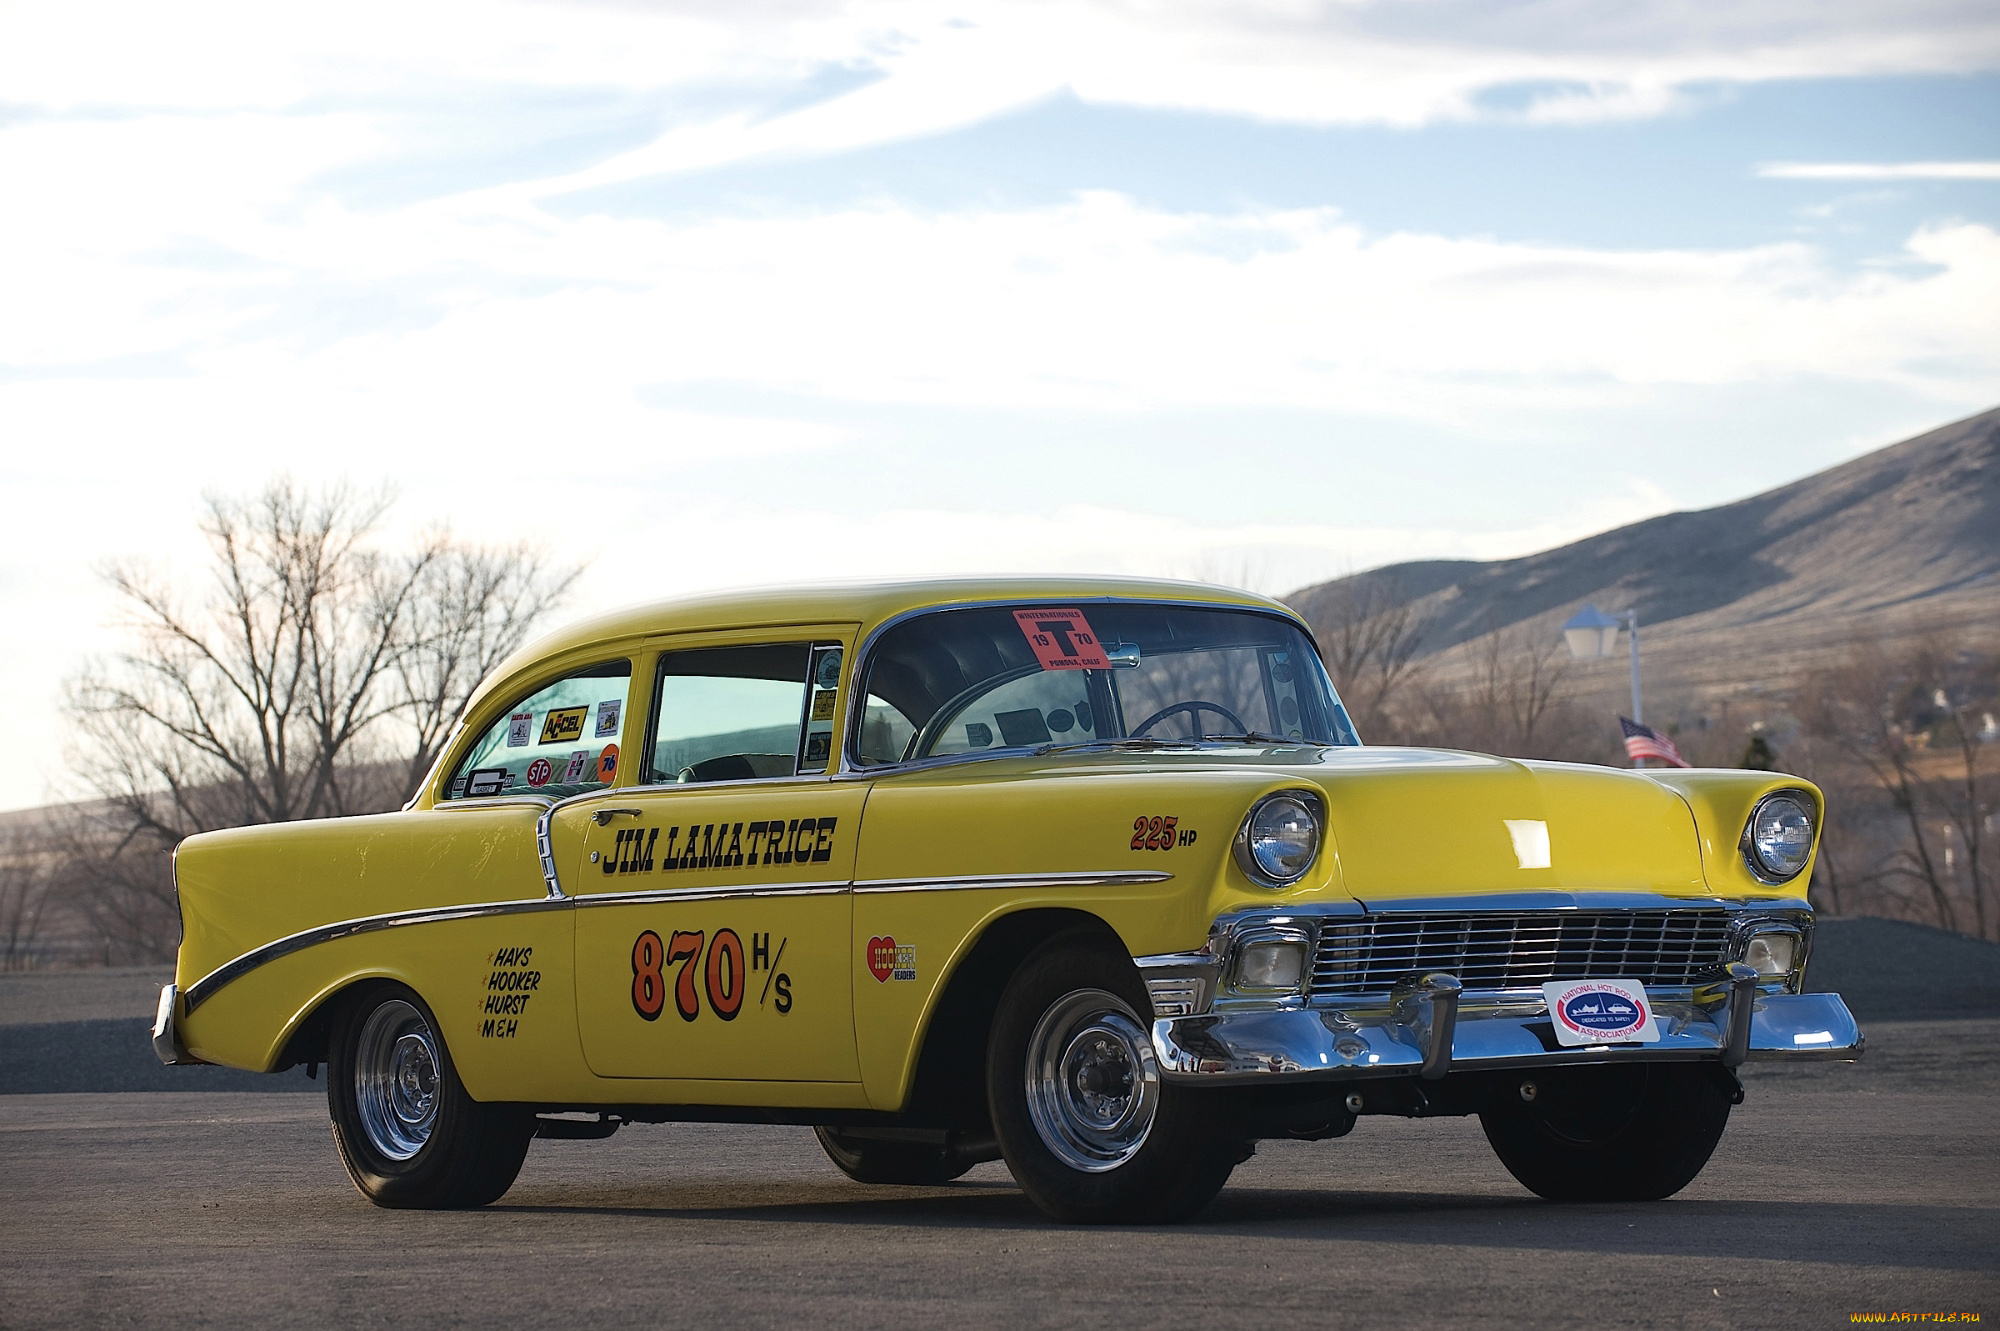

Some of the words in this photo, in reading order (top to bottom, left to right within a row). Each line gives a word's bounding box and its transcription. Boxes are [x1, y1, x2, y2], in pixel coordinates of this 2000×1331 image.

[1017, 611, 1080, 620] WINTERNATIONALS
[1032, 634, 1050, 647] 19
[1035, 620, 1079, 657] T
[1074, 633, 1093, 645] 70
[1048, 658, 1082, 667] POMONA,
[1082, 658, 1101, 666] CALIF
[529, 760, 549, 782] STP
[602, 754, 616, 772] 76
[476, 785, 494, 793] GASKET
[1130, 815, 1179, 851] 225
[1178, 829, 1198, 847] HP
[602, 827, 660, 874] JIM
[663, 816, 839, 871] LAMATRICE
[493, 947, 533, 967] HAYS
[874, 947, 916, 970] HOOKER
[488, 970, 541, 991] HOOKER
[631, 927, 746, 1023] 870
[894, 970, 916, 981] HEADERS
[1562, 984, 1596, 1002] NATIONAL
[1597, 983, 1613, 992] HOT
[1615, 988, 1632, 1000] ROD
[484, 994, 530, 1015] HURST
[1580, 1026, 1636, 1038] ASSOCIATION
